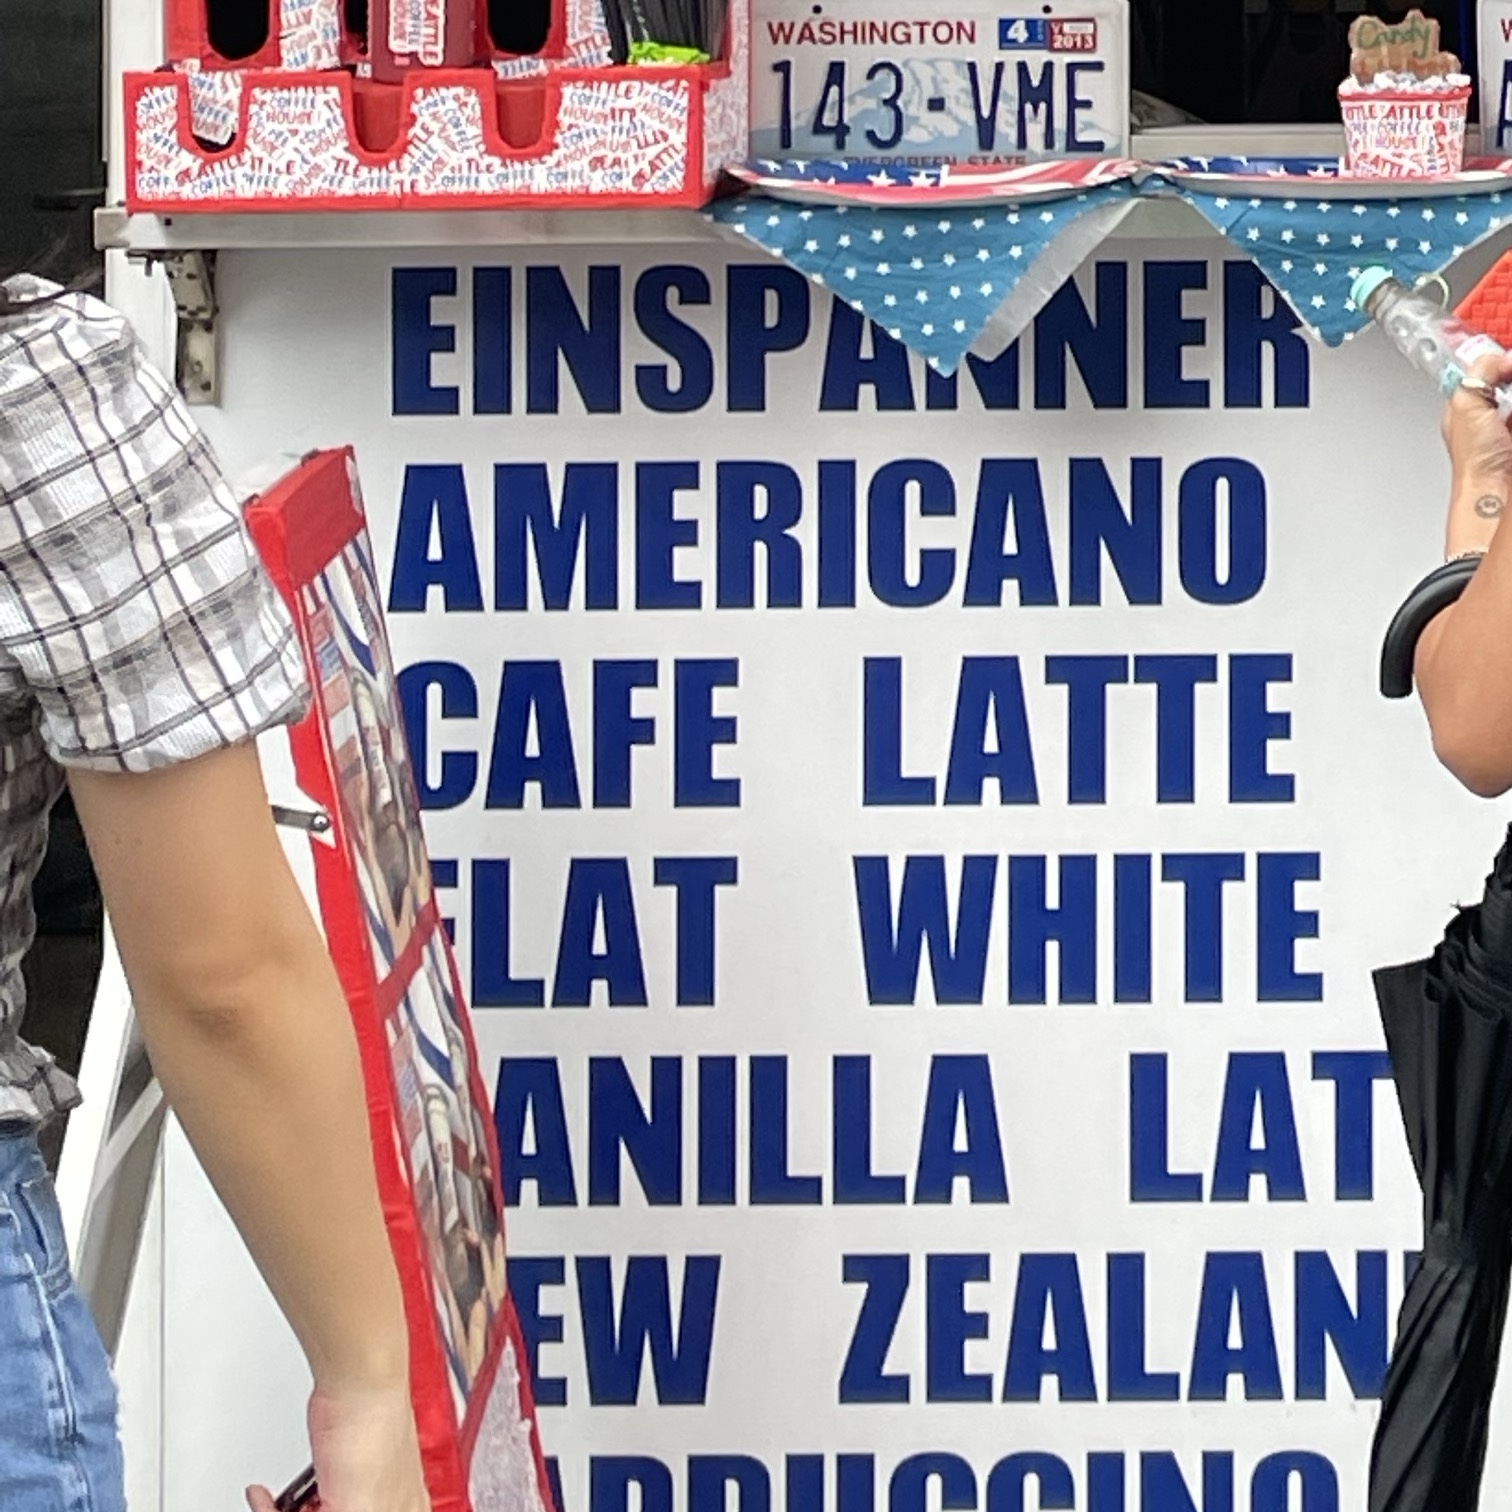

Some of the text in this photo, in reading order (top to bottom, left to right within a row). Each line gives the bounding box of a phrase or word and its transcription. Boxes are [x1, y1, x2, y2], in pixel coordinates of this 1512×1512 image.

[767, 20, 977, 46] WASHINGTON
[1006, 19, 1030, 44] 4
[1052, 34, 1095, 49] 2013
[1356, 14, 1432, 60] Candy
[772, 59, 1106, 153] 143-VME
[386, 456, 1268, 613] AMERICANO
[393, 652, 1297, 810] CAFE LATTE
[852, 852, 1324, 1006] WHITE
[498, 1051, 1398, 1207] ANILLA LAT
[507, 1250, 1424, 1407] EW ZEALAN
